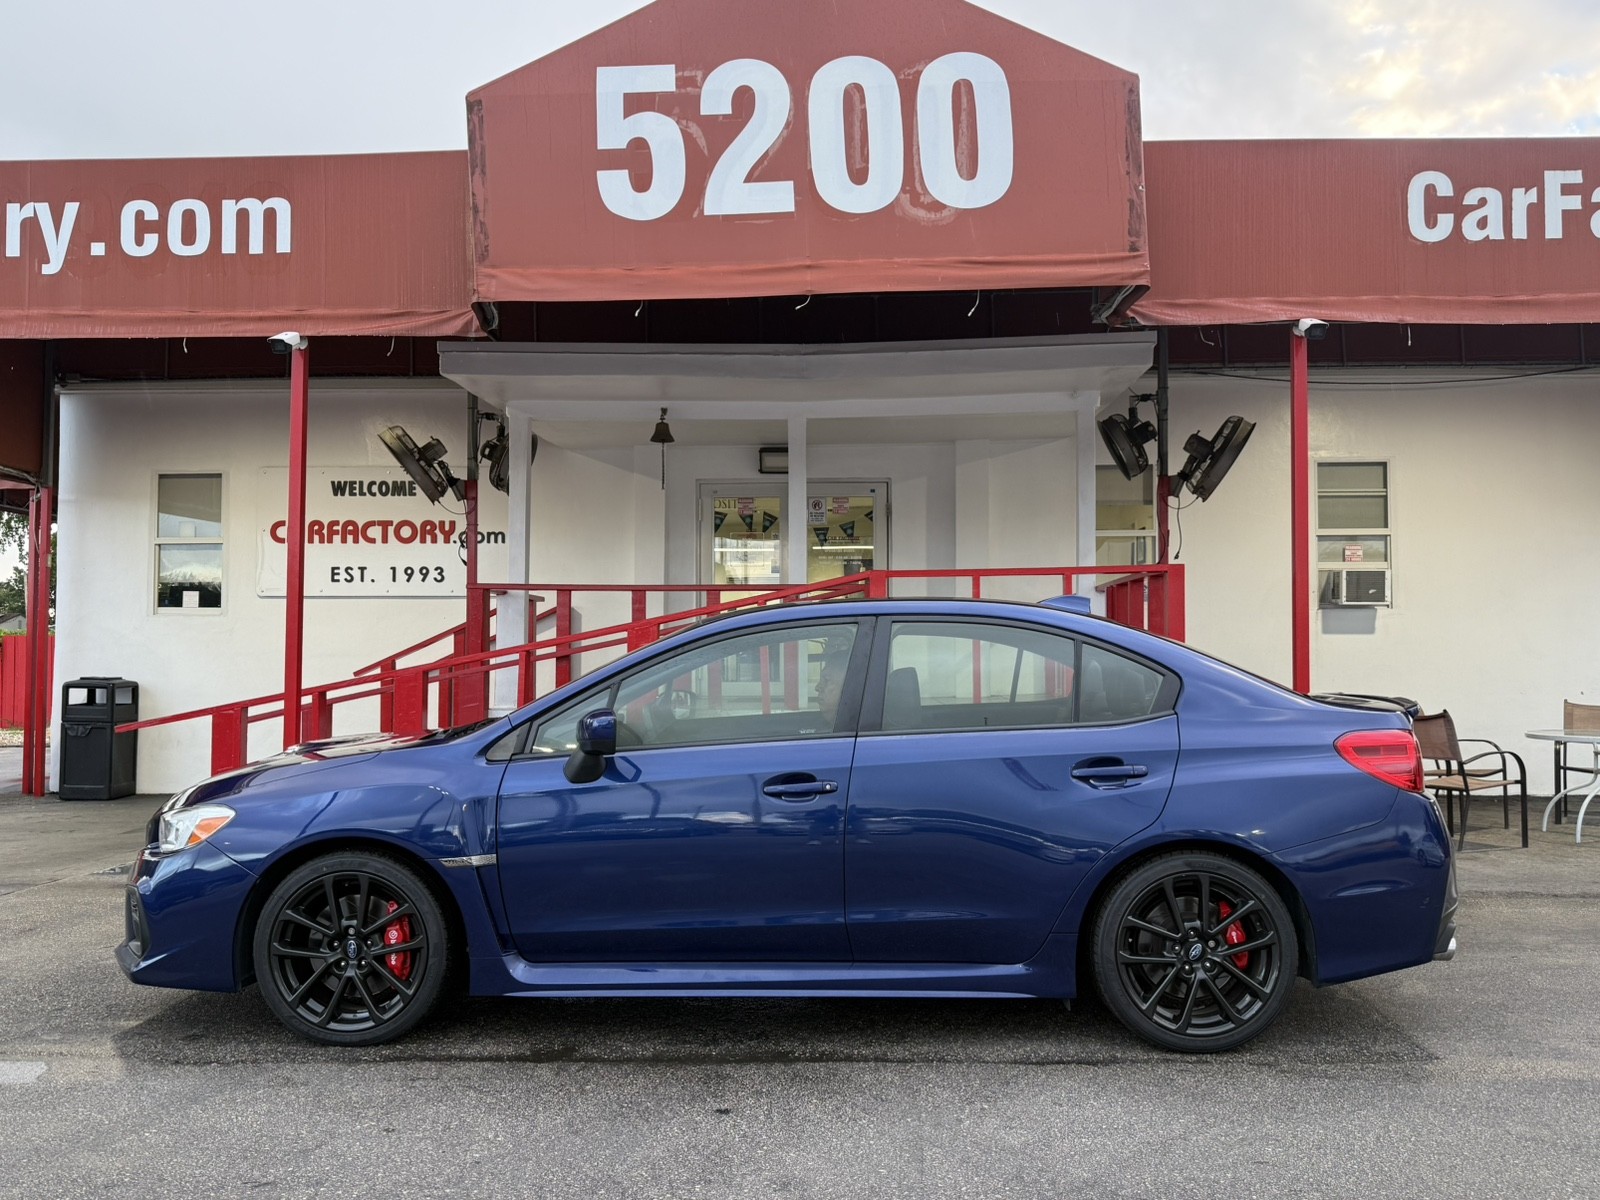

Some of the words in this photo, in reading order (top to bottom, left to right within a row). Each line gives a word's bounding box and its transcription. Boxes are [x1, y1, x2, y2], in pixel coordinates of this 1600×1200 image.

[596, 51, 1014, 221] 5200
[1407, 169, 1600, 243] CarF
[330, 480, 417, 497] WELCOME
[269, 519, 506, 545] CRFACTORY.com
[330, 566, 376, 583] EST.
[390, 566, 446, 583] 1993
